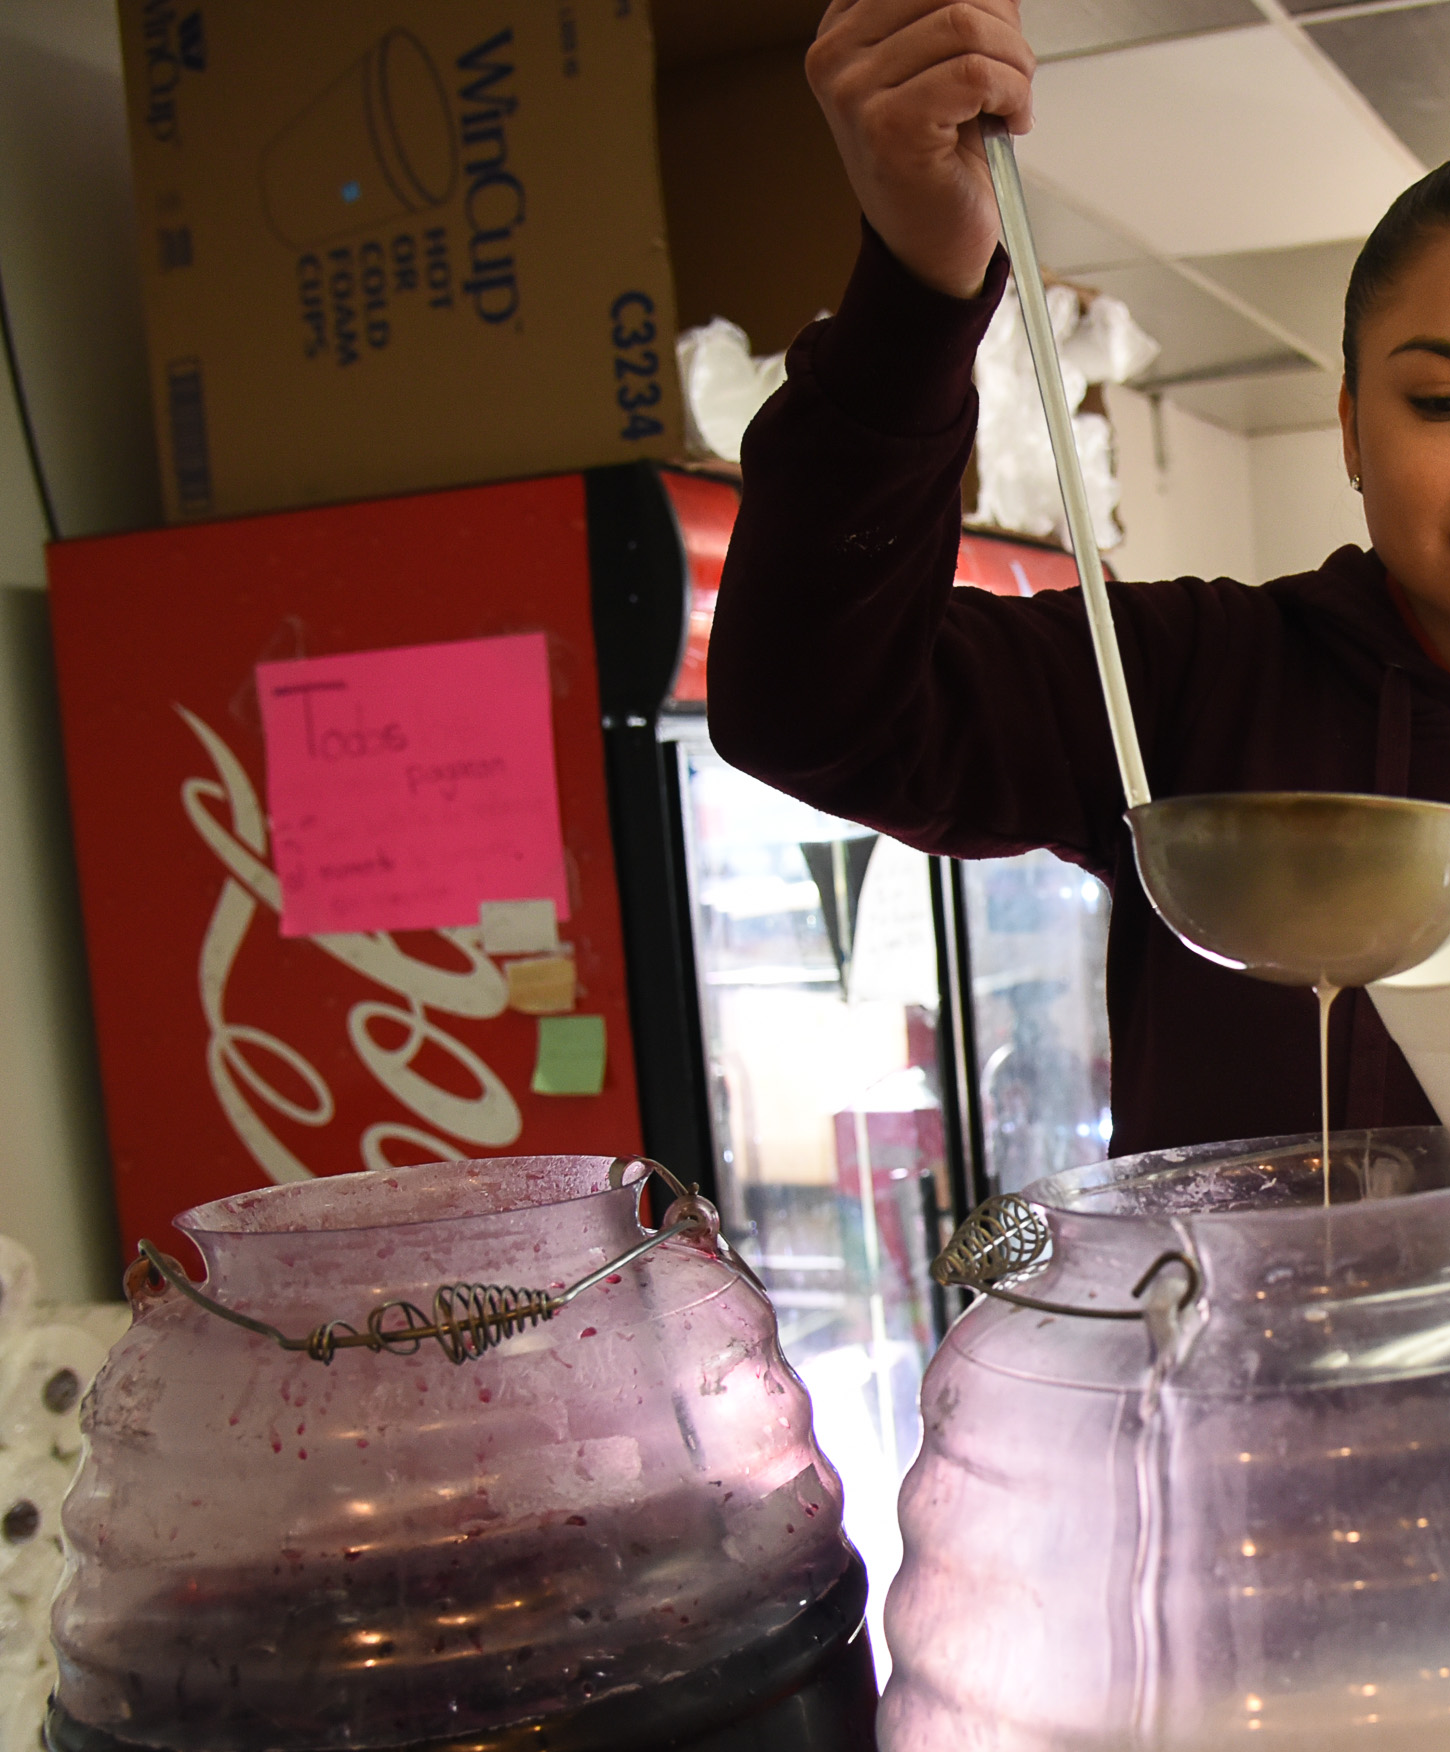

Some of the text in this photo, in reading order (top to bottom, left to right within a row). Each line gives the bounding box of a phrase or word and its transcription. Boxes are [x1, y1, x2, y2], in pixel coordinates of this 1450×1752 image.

[458, 28, 527, 325] WinCup
[299, 253, 328, 361] CUPS
[328, 248, 359, 368] FOAM
[361, 241, 392, 351] COLD
[393, 234, 420, 292] OR
[424, 227, 452, 309] HOT
[610, 289, 664, 442] C3234
